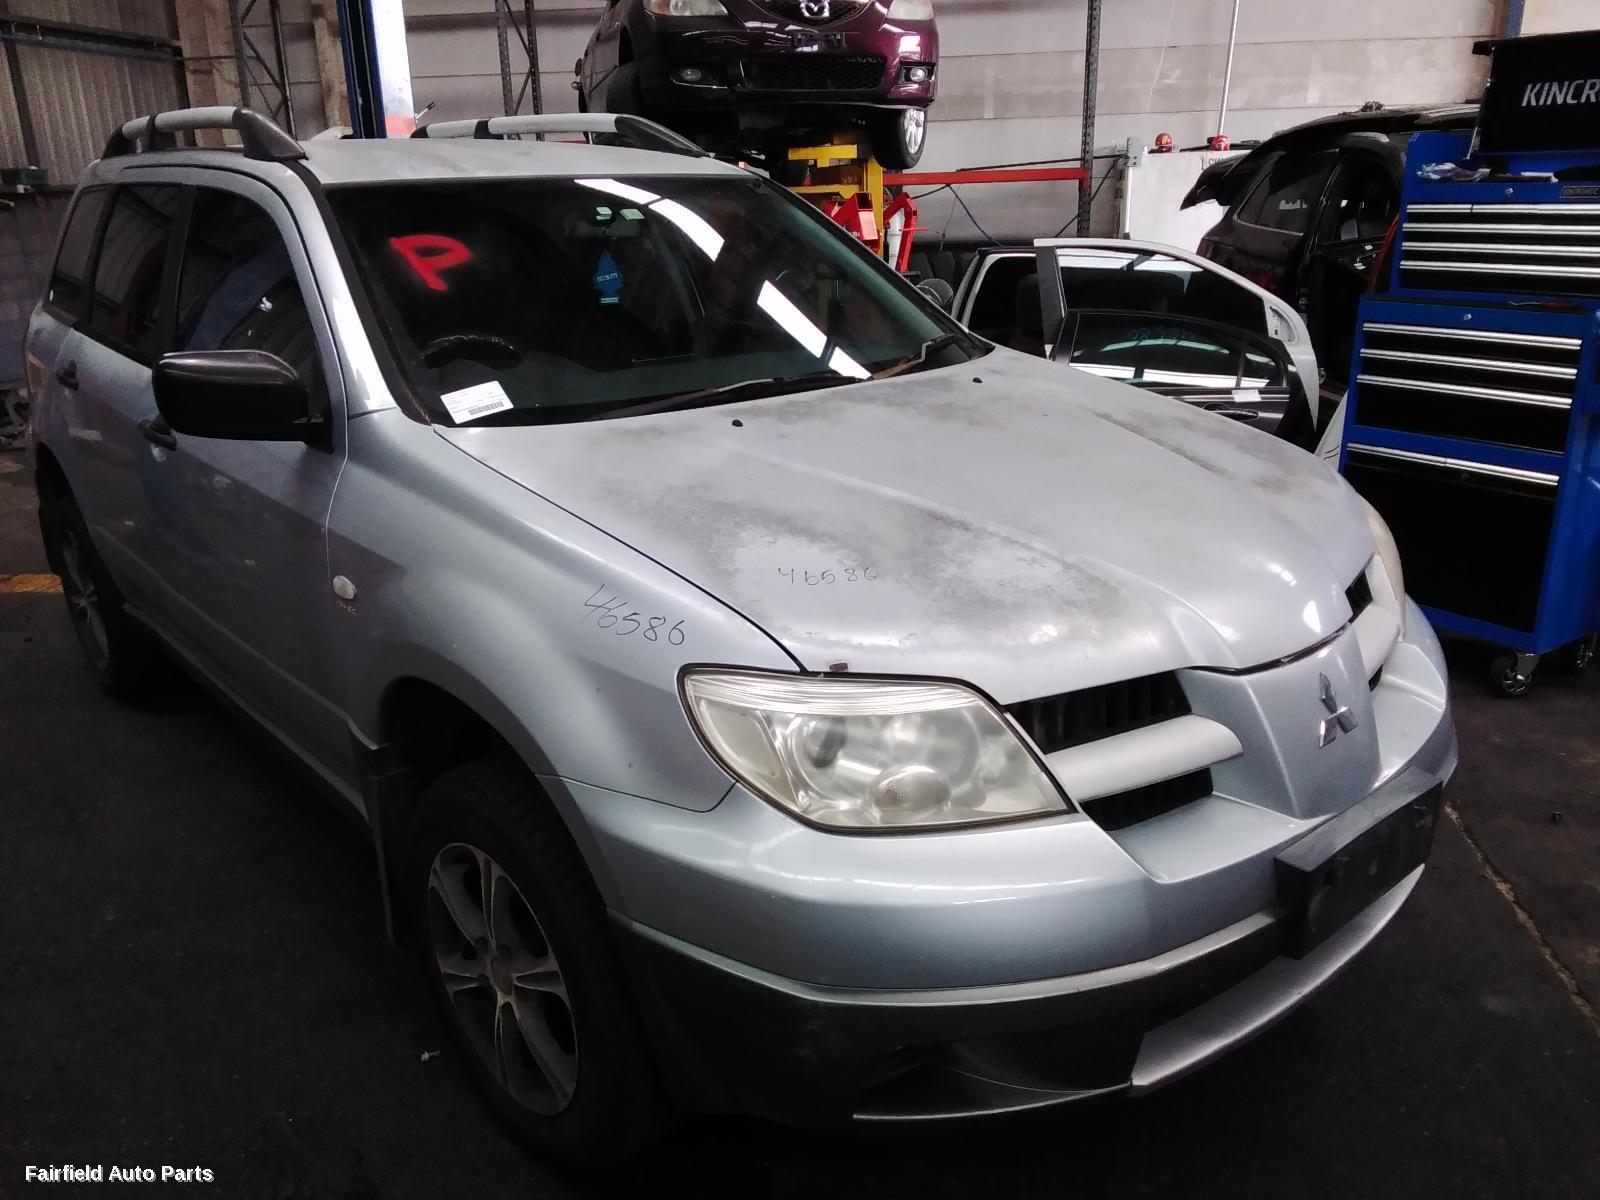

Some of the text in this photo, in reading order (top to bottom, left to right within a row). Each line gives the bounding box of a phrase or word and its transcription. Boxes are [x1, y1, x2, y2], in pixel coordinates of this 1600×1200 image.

[1521, 78, 1600, 107] KINCR
[389, 234, 472, 292] P
[777, 566, 878, 586] 46586
[583, 583, 686, 646] 46586
